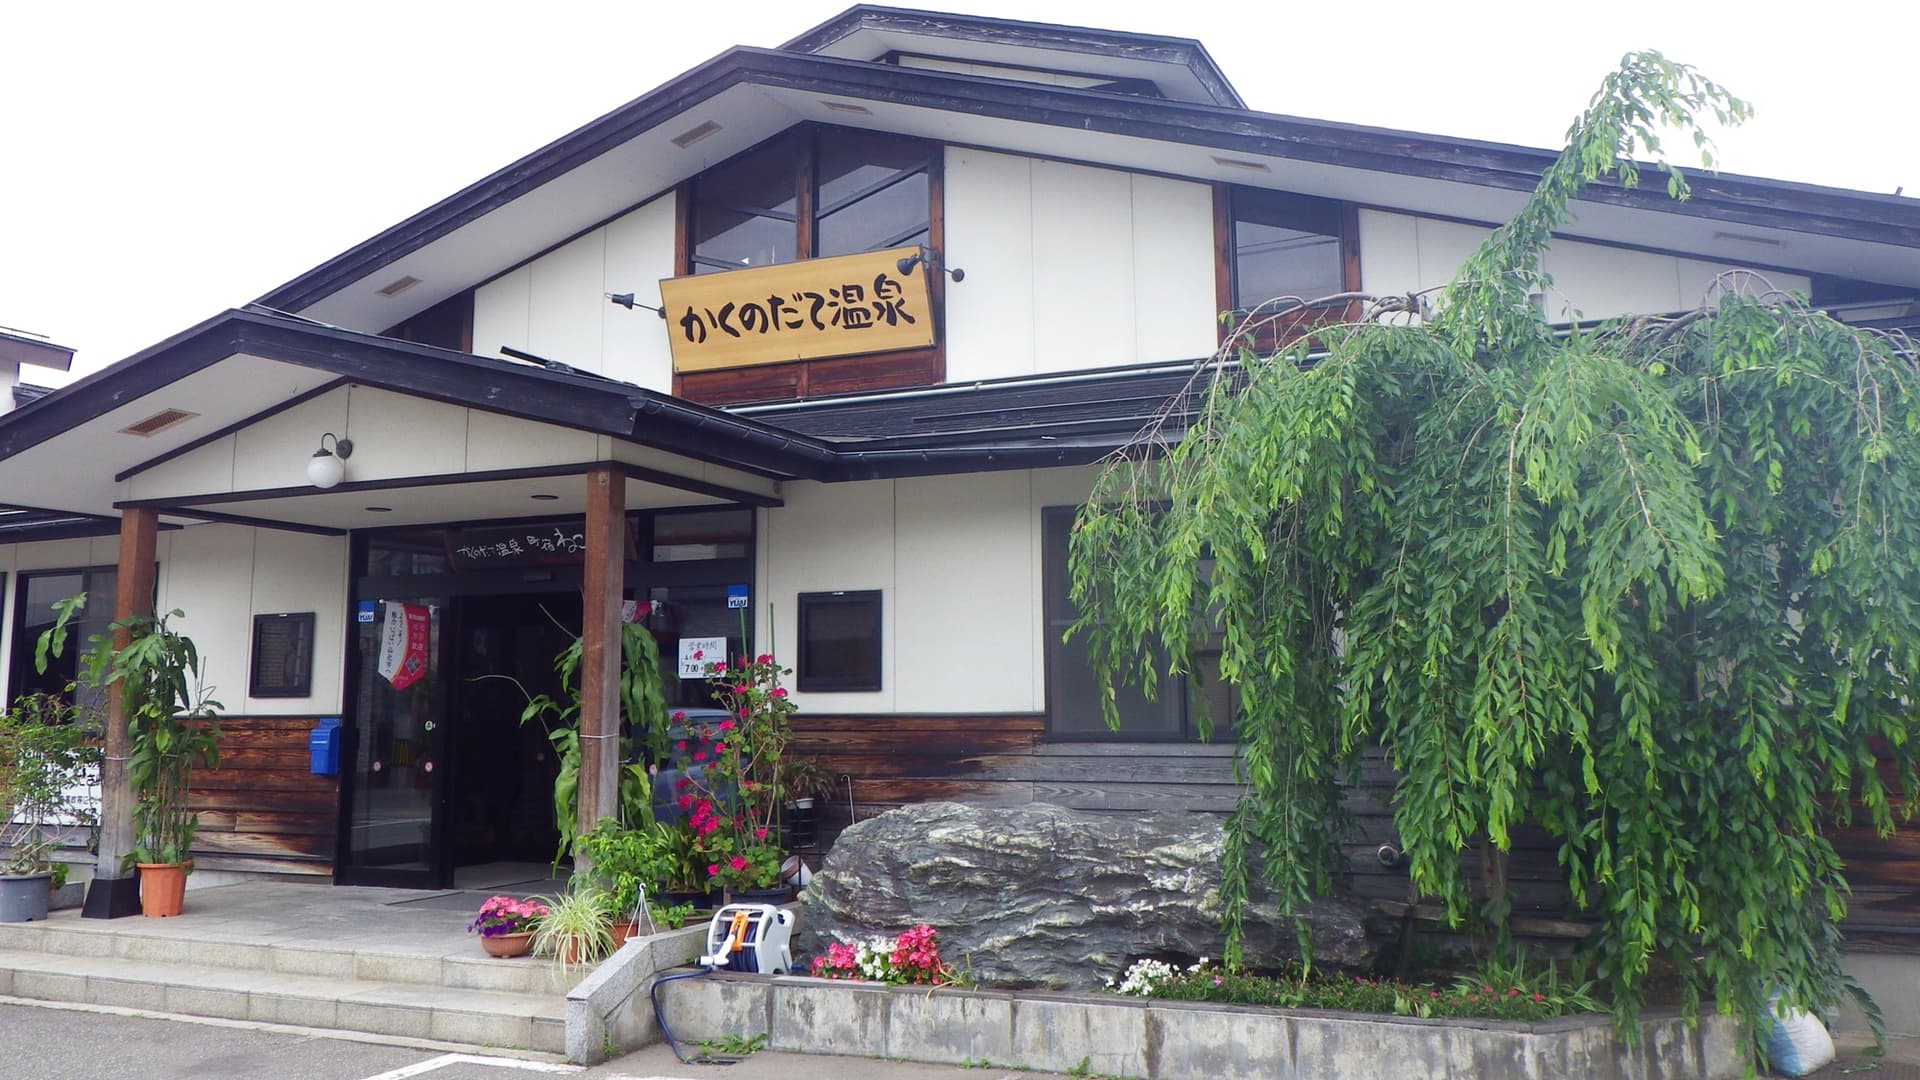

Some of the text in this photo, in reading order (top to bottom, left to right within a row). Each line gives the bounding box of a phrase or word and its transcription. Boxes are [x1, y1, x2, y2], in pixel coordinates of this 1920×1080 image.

[680, 273, 915, 343] かくのだて温泉
